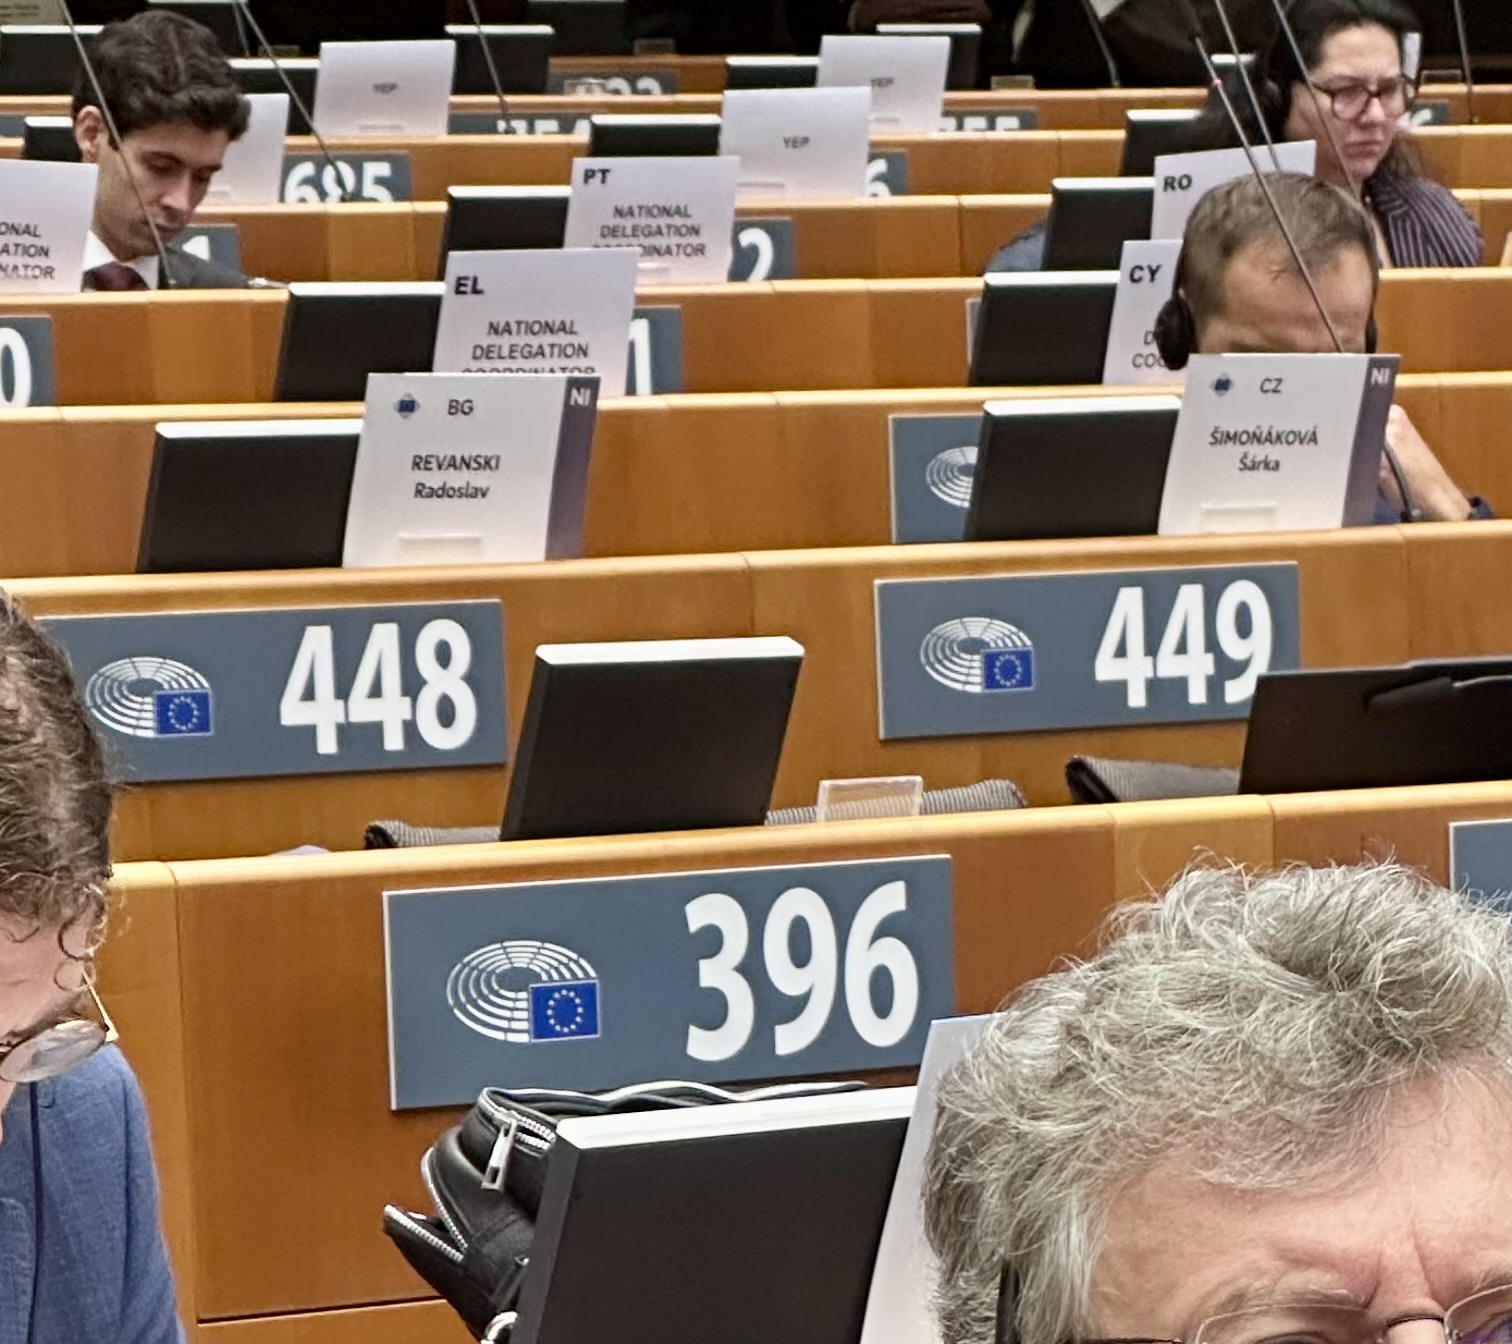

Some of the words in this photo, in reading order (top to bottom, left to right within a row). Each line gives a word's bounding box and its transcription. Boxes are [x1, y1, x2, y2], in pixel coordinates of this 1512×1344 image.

[783, 136, 809, 149] YEP
[583, 168, 611, 185] PT
[1162, 174, 1193, 193] RO
[613, 204, 692, 218] NATIONAL
[600, 224, 701, 238] DELEGATION
[1128, 264, 1162, 283] CY
[454, 276, 484, 295] EL
[487, 320, 578, 336] NATIONAL
[472, 342, 589, 360] DELEGATION
[1370, 367, 1390, 385] NI
[1259, 378, 1283, 394] CZ
[569, 388, 591, 406] NI
[447, 399, 474, 416] BG
[411, 454, 501, 472] REVANSKI
[1238, 451, 1280, 471] Šárka
[413, 481, 490, 499] Radoslav
[1094, 579, 1272, 708] 449
[279, 618, 477, 755] 448
[684, 880, 920, 1061] 396
